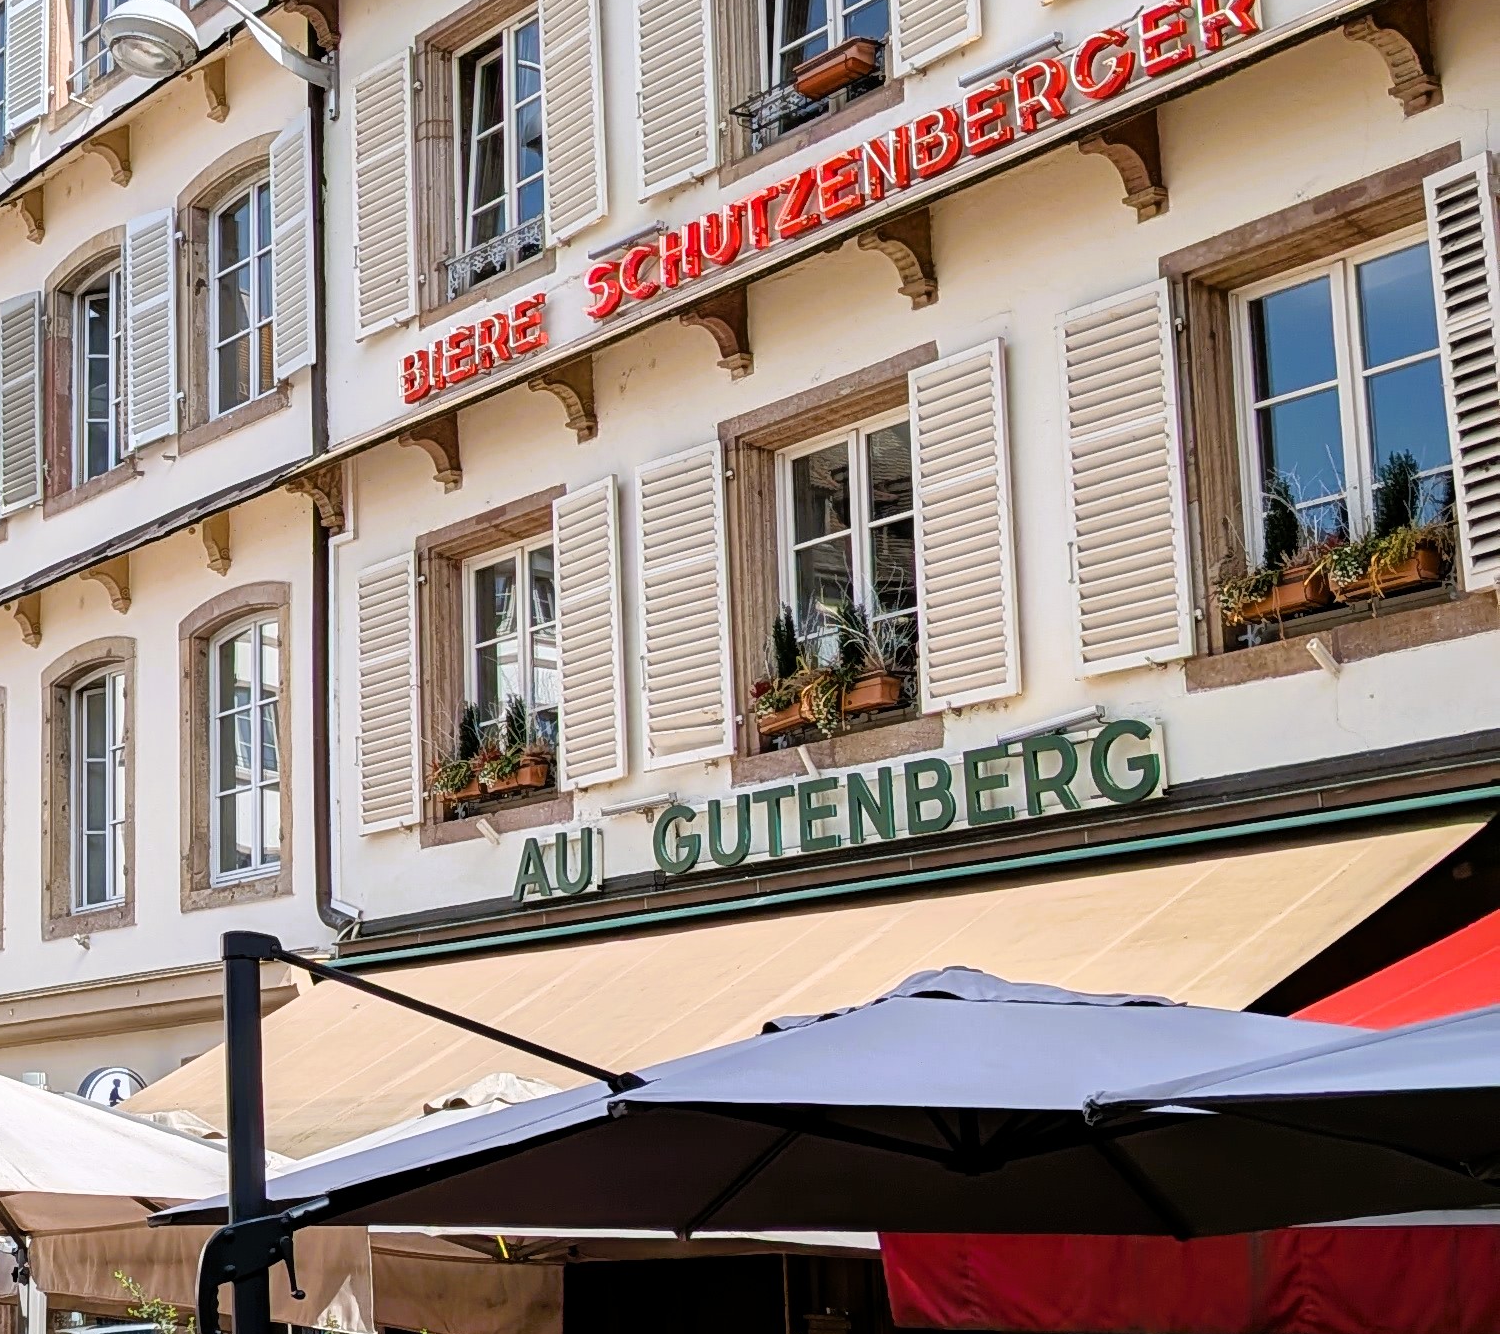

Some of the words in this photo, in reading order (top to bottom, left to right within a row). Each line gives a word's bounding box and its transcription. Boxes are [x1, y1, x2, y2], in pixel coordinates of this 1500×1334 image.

[396, 292, 550, 405] BIERE
[512, 826, 594, 902] AU
[652, 720, 1161, 875] GUTENBERG
